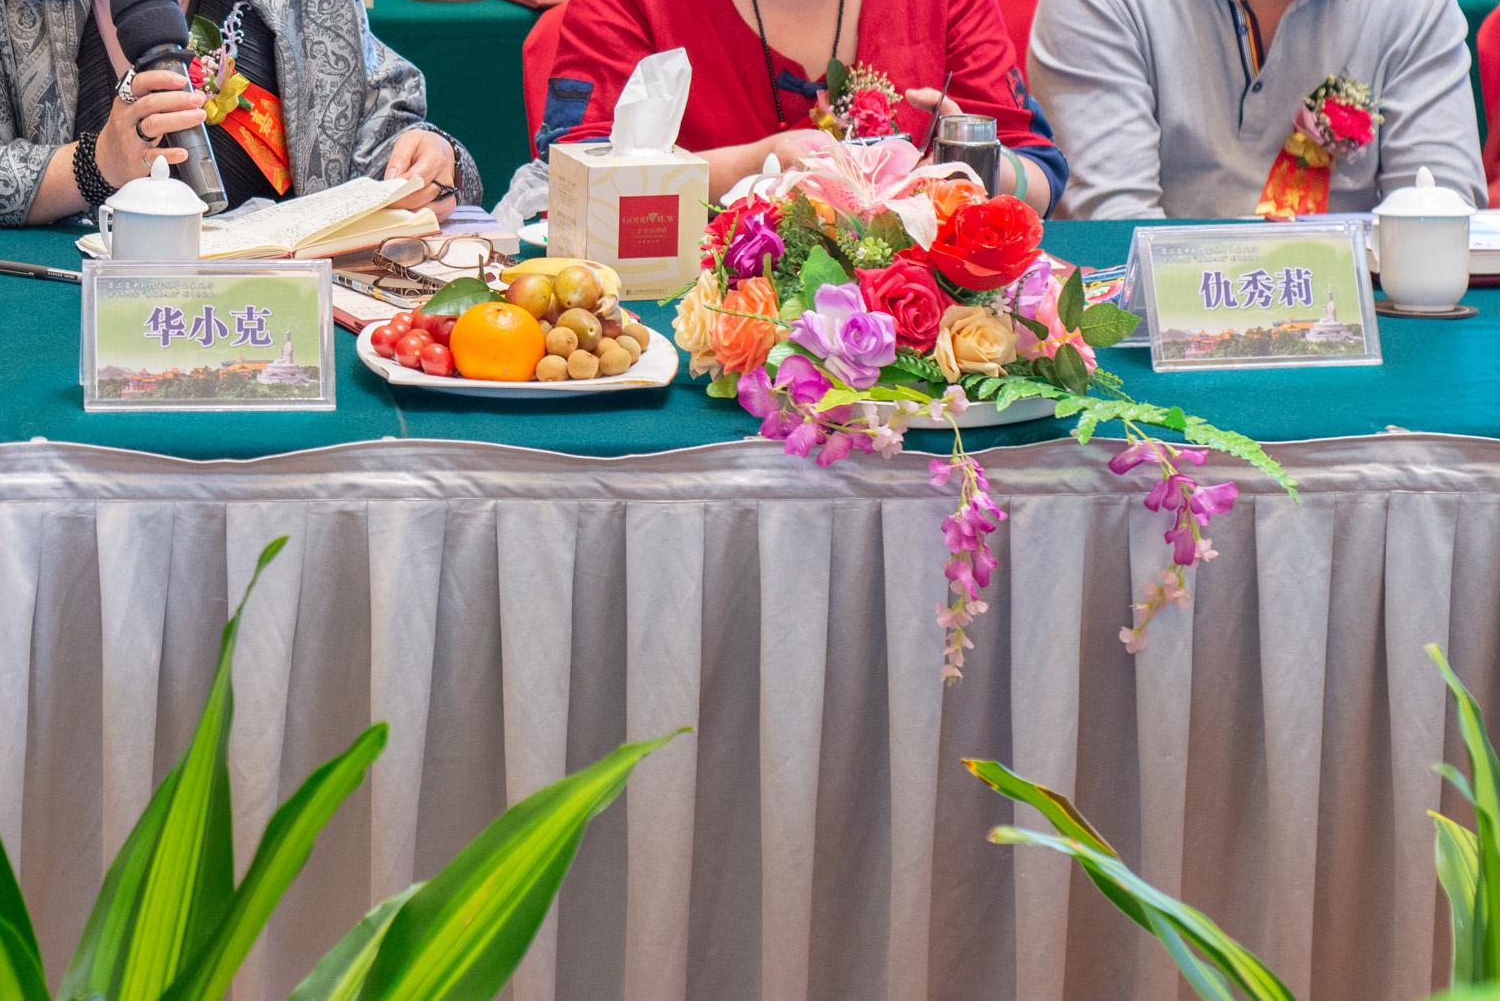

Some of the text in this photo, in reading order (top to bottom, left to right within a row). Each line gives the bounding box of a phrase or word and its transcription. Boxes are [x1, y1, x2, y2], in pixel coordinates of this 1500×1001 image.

[1199, 267, 1314, 310] 仇秀莉
[144, 305, 273, 347] 华小克
